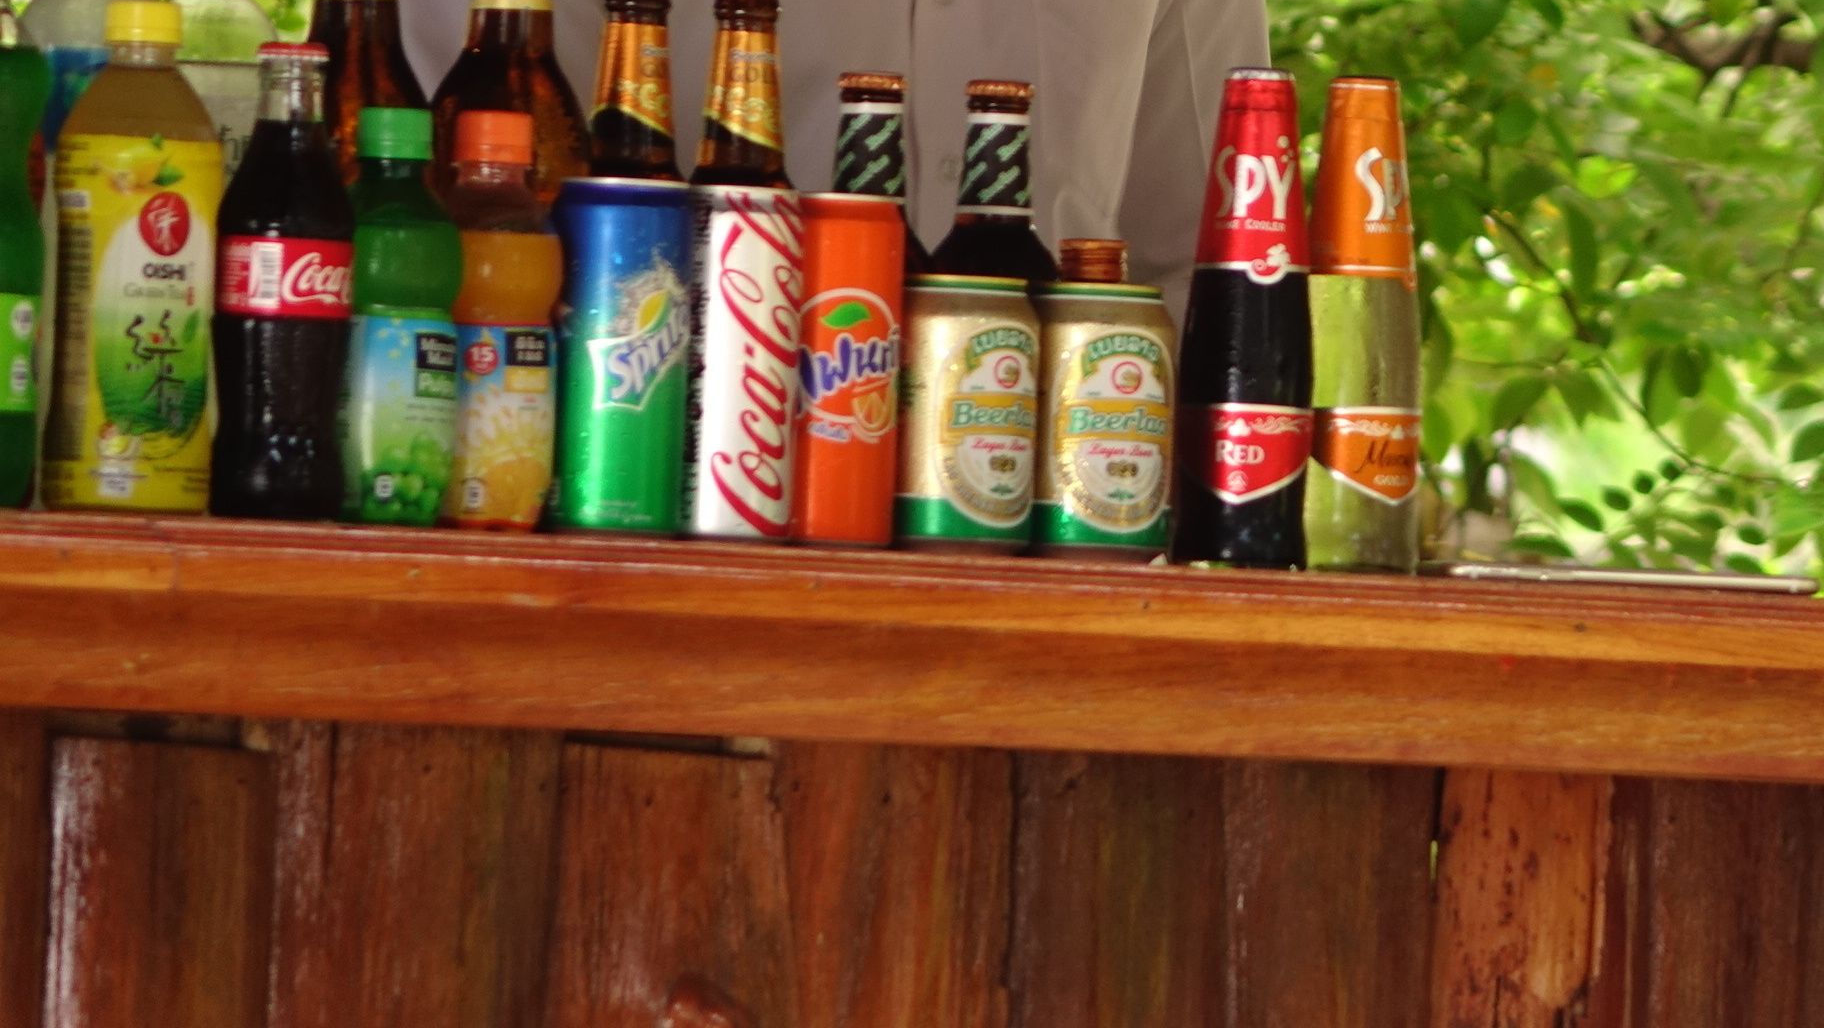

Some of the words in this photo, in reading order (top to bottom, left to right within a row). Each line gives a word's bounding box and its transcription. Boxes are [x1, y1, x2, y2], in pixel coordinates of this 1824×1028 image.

[1214, 144, 1296, 221] SPY
[469, 345, 496, 362] 15
[1215, 438, 1266, 465] RED
